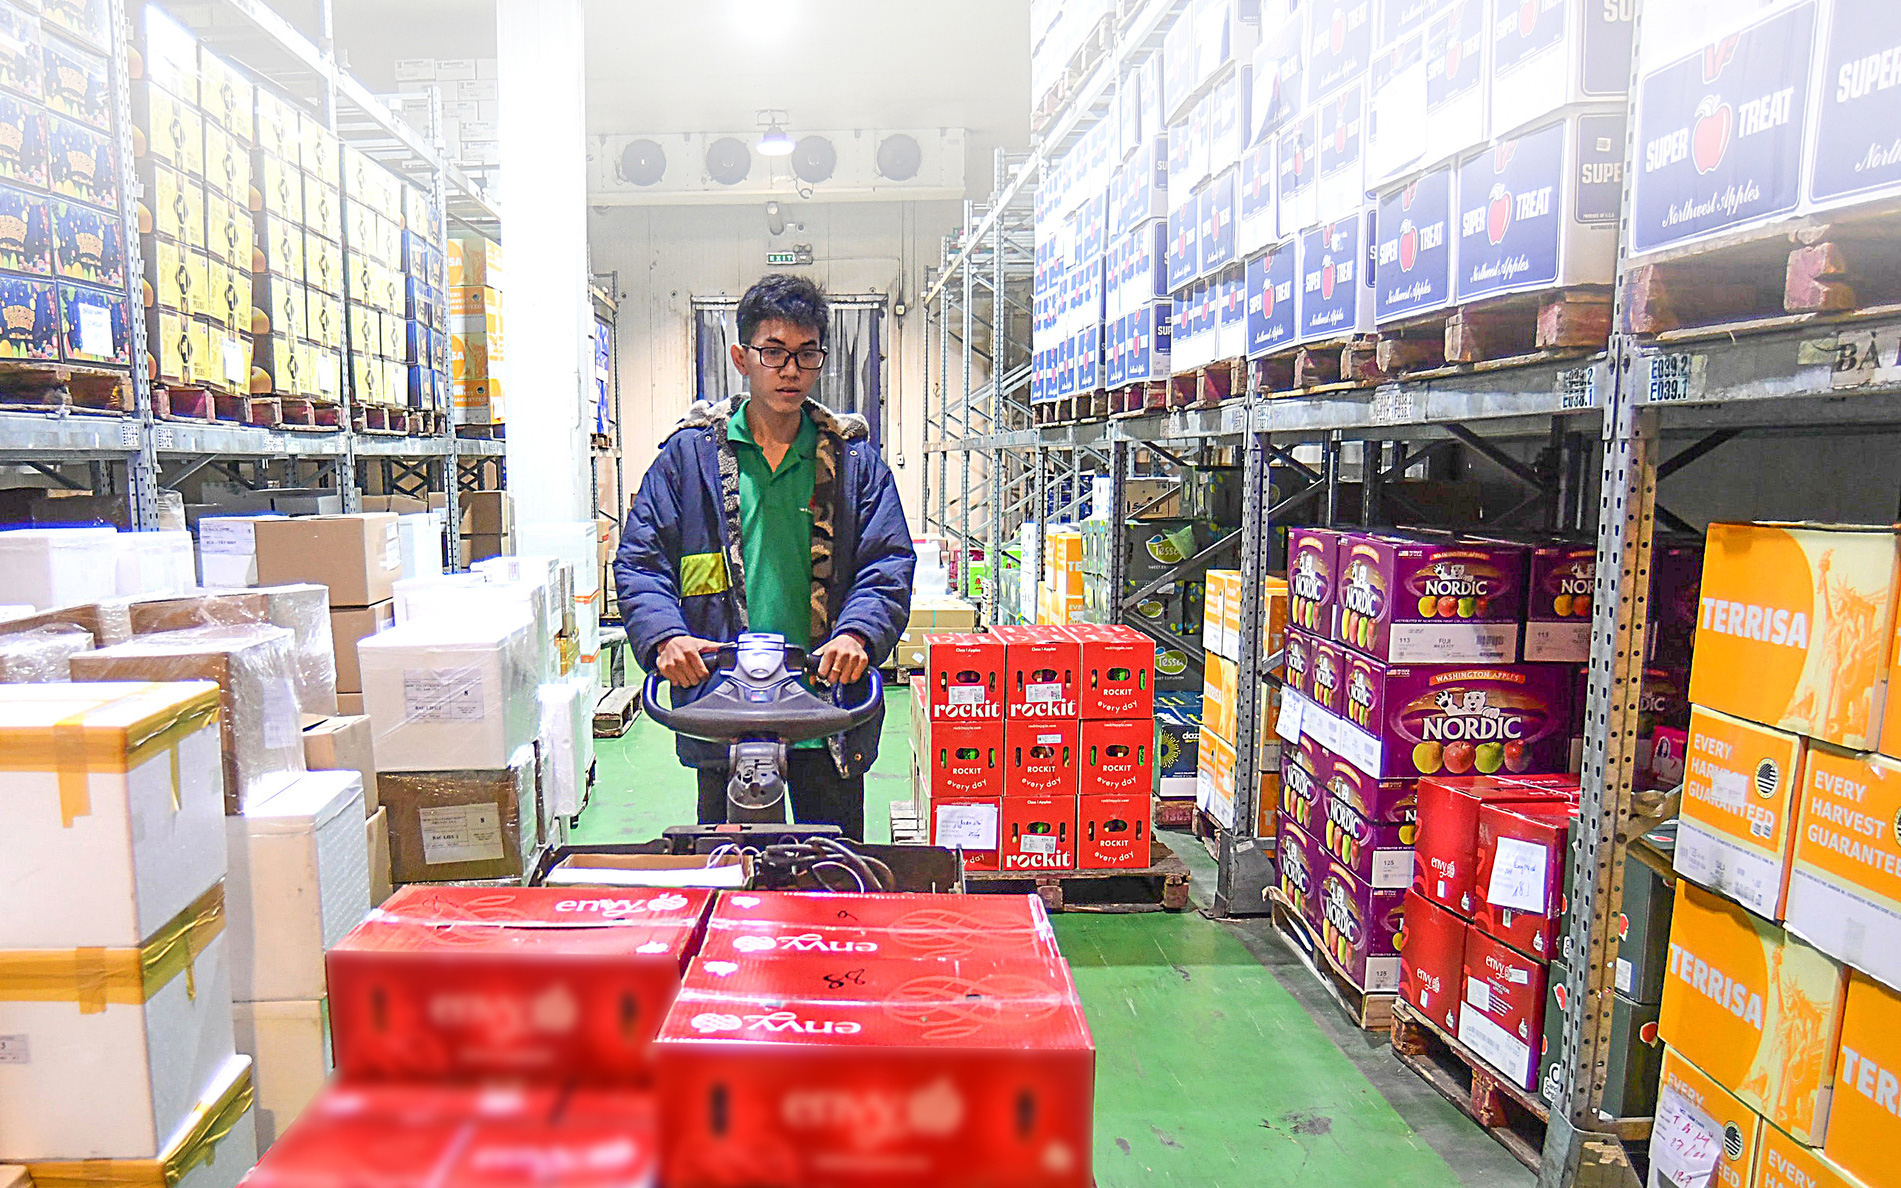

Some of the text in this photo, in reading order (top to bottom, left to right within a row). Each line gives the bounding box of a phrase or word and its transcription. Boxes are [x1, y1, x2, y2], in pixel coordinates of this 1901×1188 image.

[1645, 86, 1795, 173] SUPER TREAT
[1462, 206, 1486, 238] SUPER
[1515, 186, 1552, 222] TREAT
[1662, 179, 1760, 228] Northwest Apples
[1379, 221, 1444, 267] SUPER TREAT
[1336, 260, 1354, 284] TREAT
[1651, 355, 1688, 380] E039.2
[1650, 380, 1688, 401] E039.1
[1295, 575, 1321, 600] NORDIC
[1425, 580, 1488, 596] NORDIC
[1345, 586, 1377, 617] NORDIC
[1702, 597, 1807, 650] TERRISA
[1435, 671, 1490, 683] WASHINGTON
[1103, 688, 1133, 696] ROCKIT
[934, 700, 1001, 718] rockit
[1010, 698, 1077, 717] rockit
[1097, 700, 1138, 714] every day
[1422, 716, 1523, 740] NORDIC
[1693, 733, 1732, 760] EVERY
[952, 767, 981, 775] ROCKIT
[1027, 765, 1056, 773] ROCKIT
[1102, 764, 1131, 772] ROCKIT
[947, 778, 987, 792] every day
[1021, 776, 1061, 790] every day
[1096, 775, 1137, 789] every day
[1288, 765, 1311, 800] NORDIC
[1814, 769, 1867, 803] EVERY
[1330, 798, 1360, 838] NORDIC
[1811, 796, 1886, 840] HARVEST
[968, 853, 985, 865] day
[1006, 850, 1071, 868] rockit
[1094, 850, 1134, 863] every day
[1430, 856, 1448, 878] envy
[1282, 855, 1306, 893] NORDIC
[556, 897, 647, 918] envy
[1325, 899, 1354, 942] NORDIC
[776, 933, 878, 953] envy
[1416, 967, 1434, 991] envy
[1485, 955, 1505, 980] envy
[1669, 942, 1763, 1031] TERRISA
[743, 1012, 861, 1034] envy
